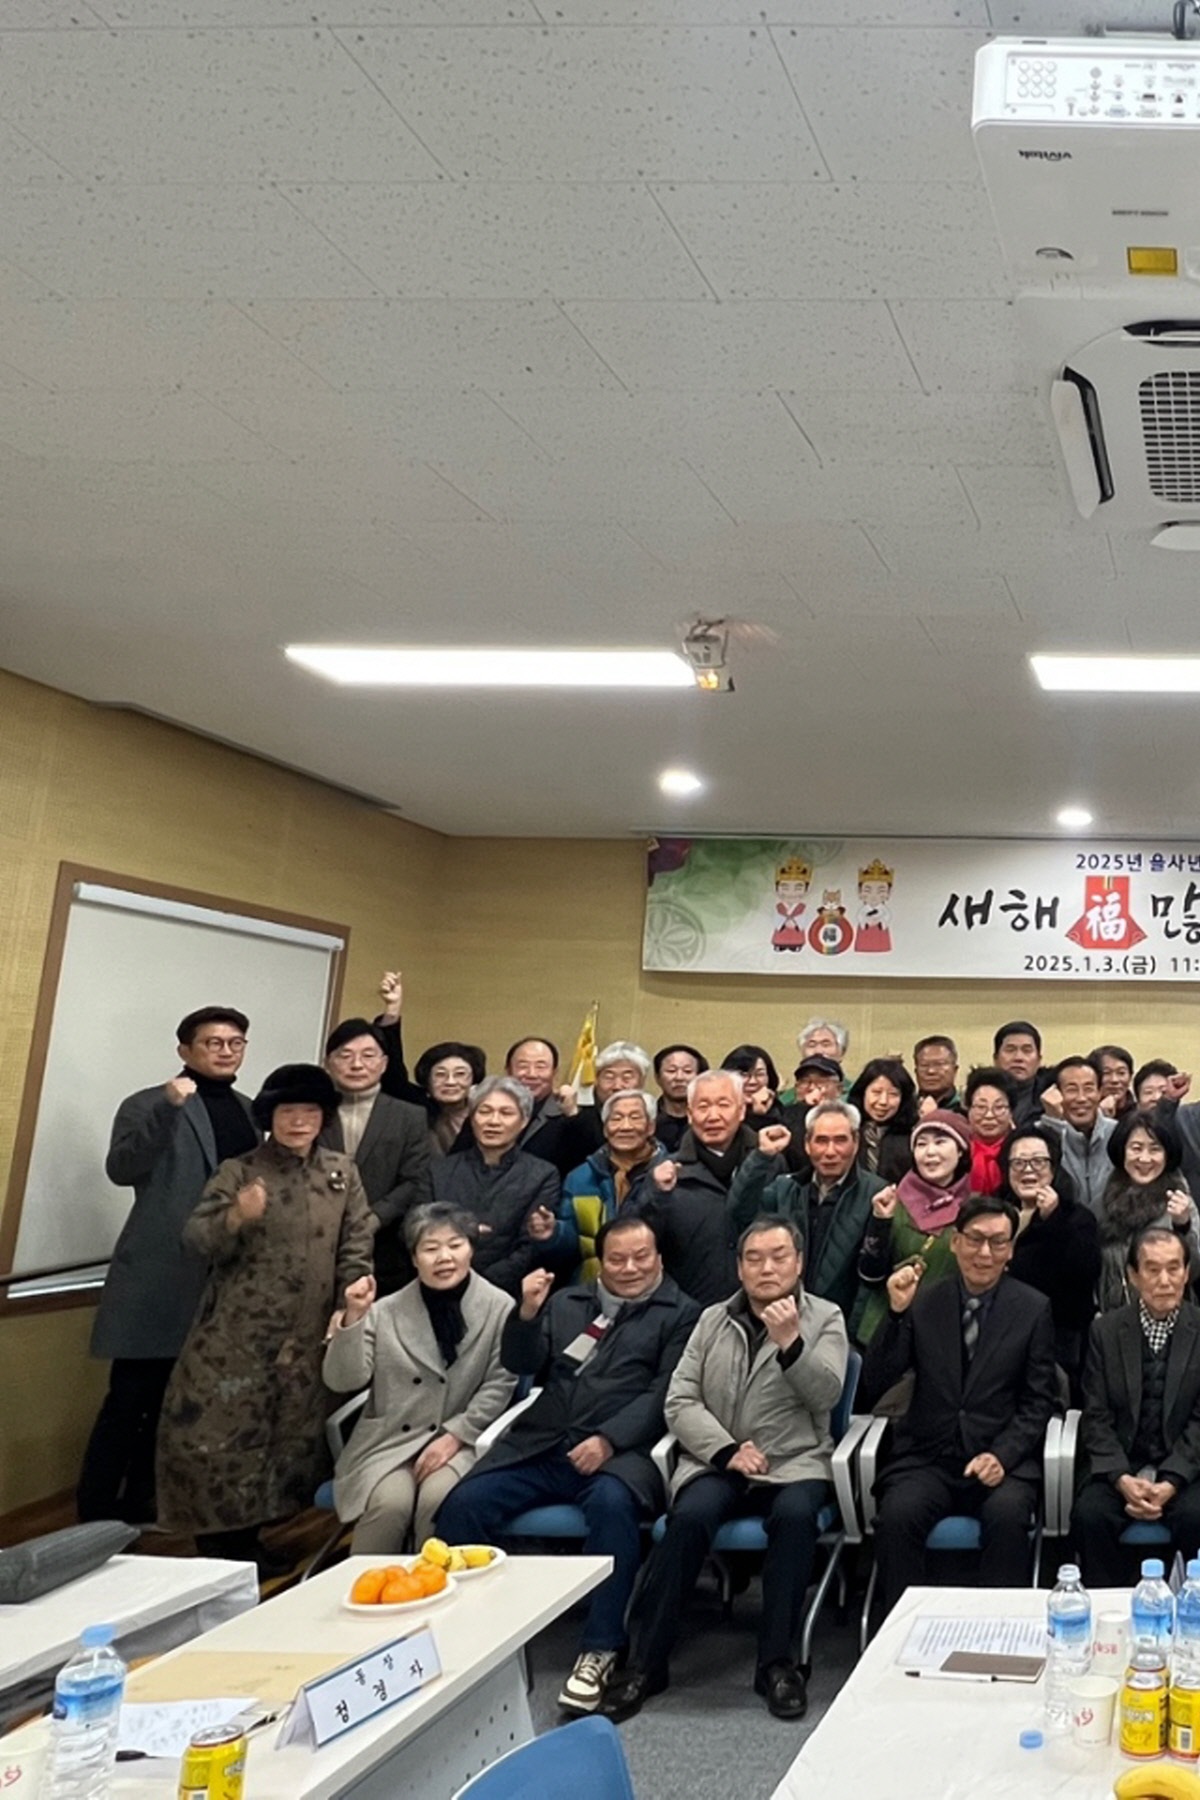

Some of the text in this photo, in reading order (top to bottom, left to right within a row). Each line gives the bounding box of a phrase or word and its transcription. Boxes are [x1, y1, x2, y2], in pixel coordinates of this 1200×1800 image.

[1075, 852, 1143, 873] 2025년
[938, 888, 1060, 932] 새해
[1085, 890, 1128, 942] 福
[1023, 955, 1157, 975] 2025.1.3.(금)
